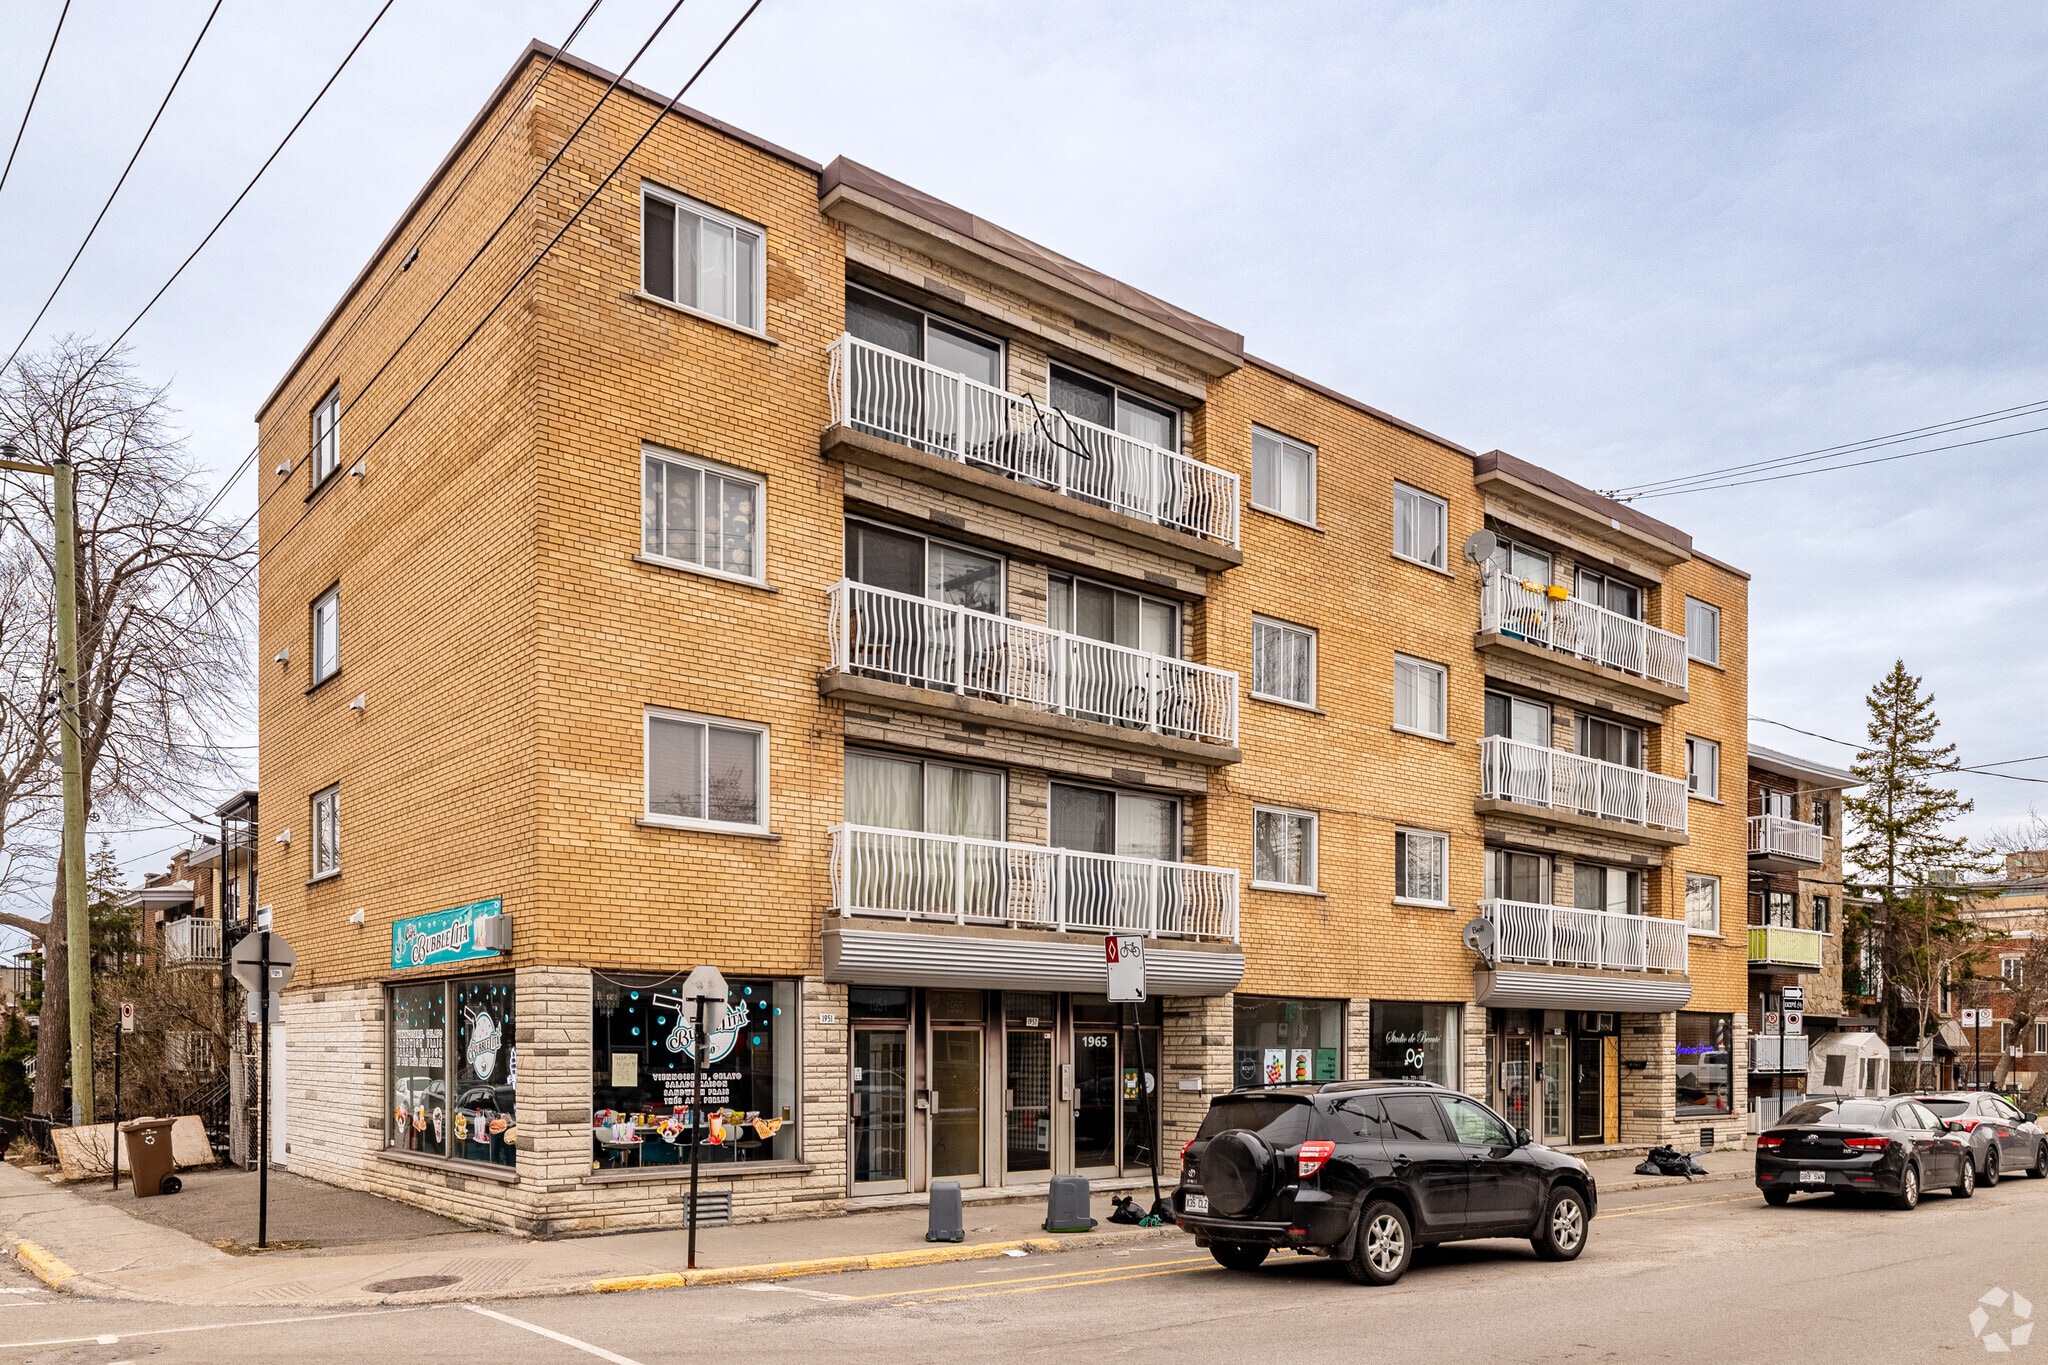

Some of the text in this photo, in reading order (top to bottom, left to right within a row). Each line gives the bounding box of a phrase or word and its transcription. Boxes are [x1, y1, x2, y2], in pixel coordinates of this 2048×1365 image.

[1472, 924, 1485, 934] Bell
[821, 1015, 833, 1023] 1951
[1082, 1036, 1107, 1047] 1965
[652, 1072, 743, 1081] VIENNOISEIE, GELATO
[665, 1081, 695, 1089] SALADE
[663, 1088, 730, 1097] SANDWIH FRAIS
[703, 1096, 730, 1104] PERLES
